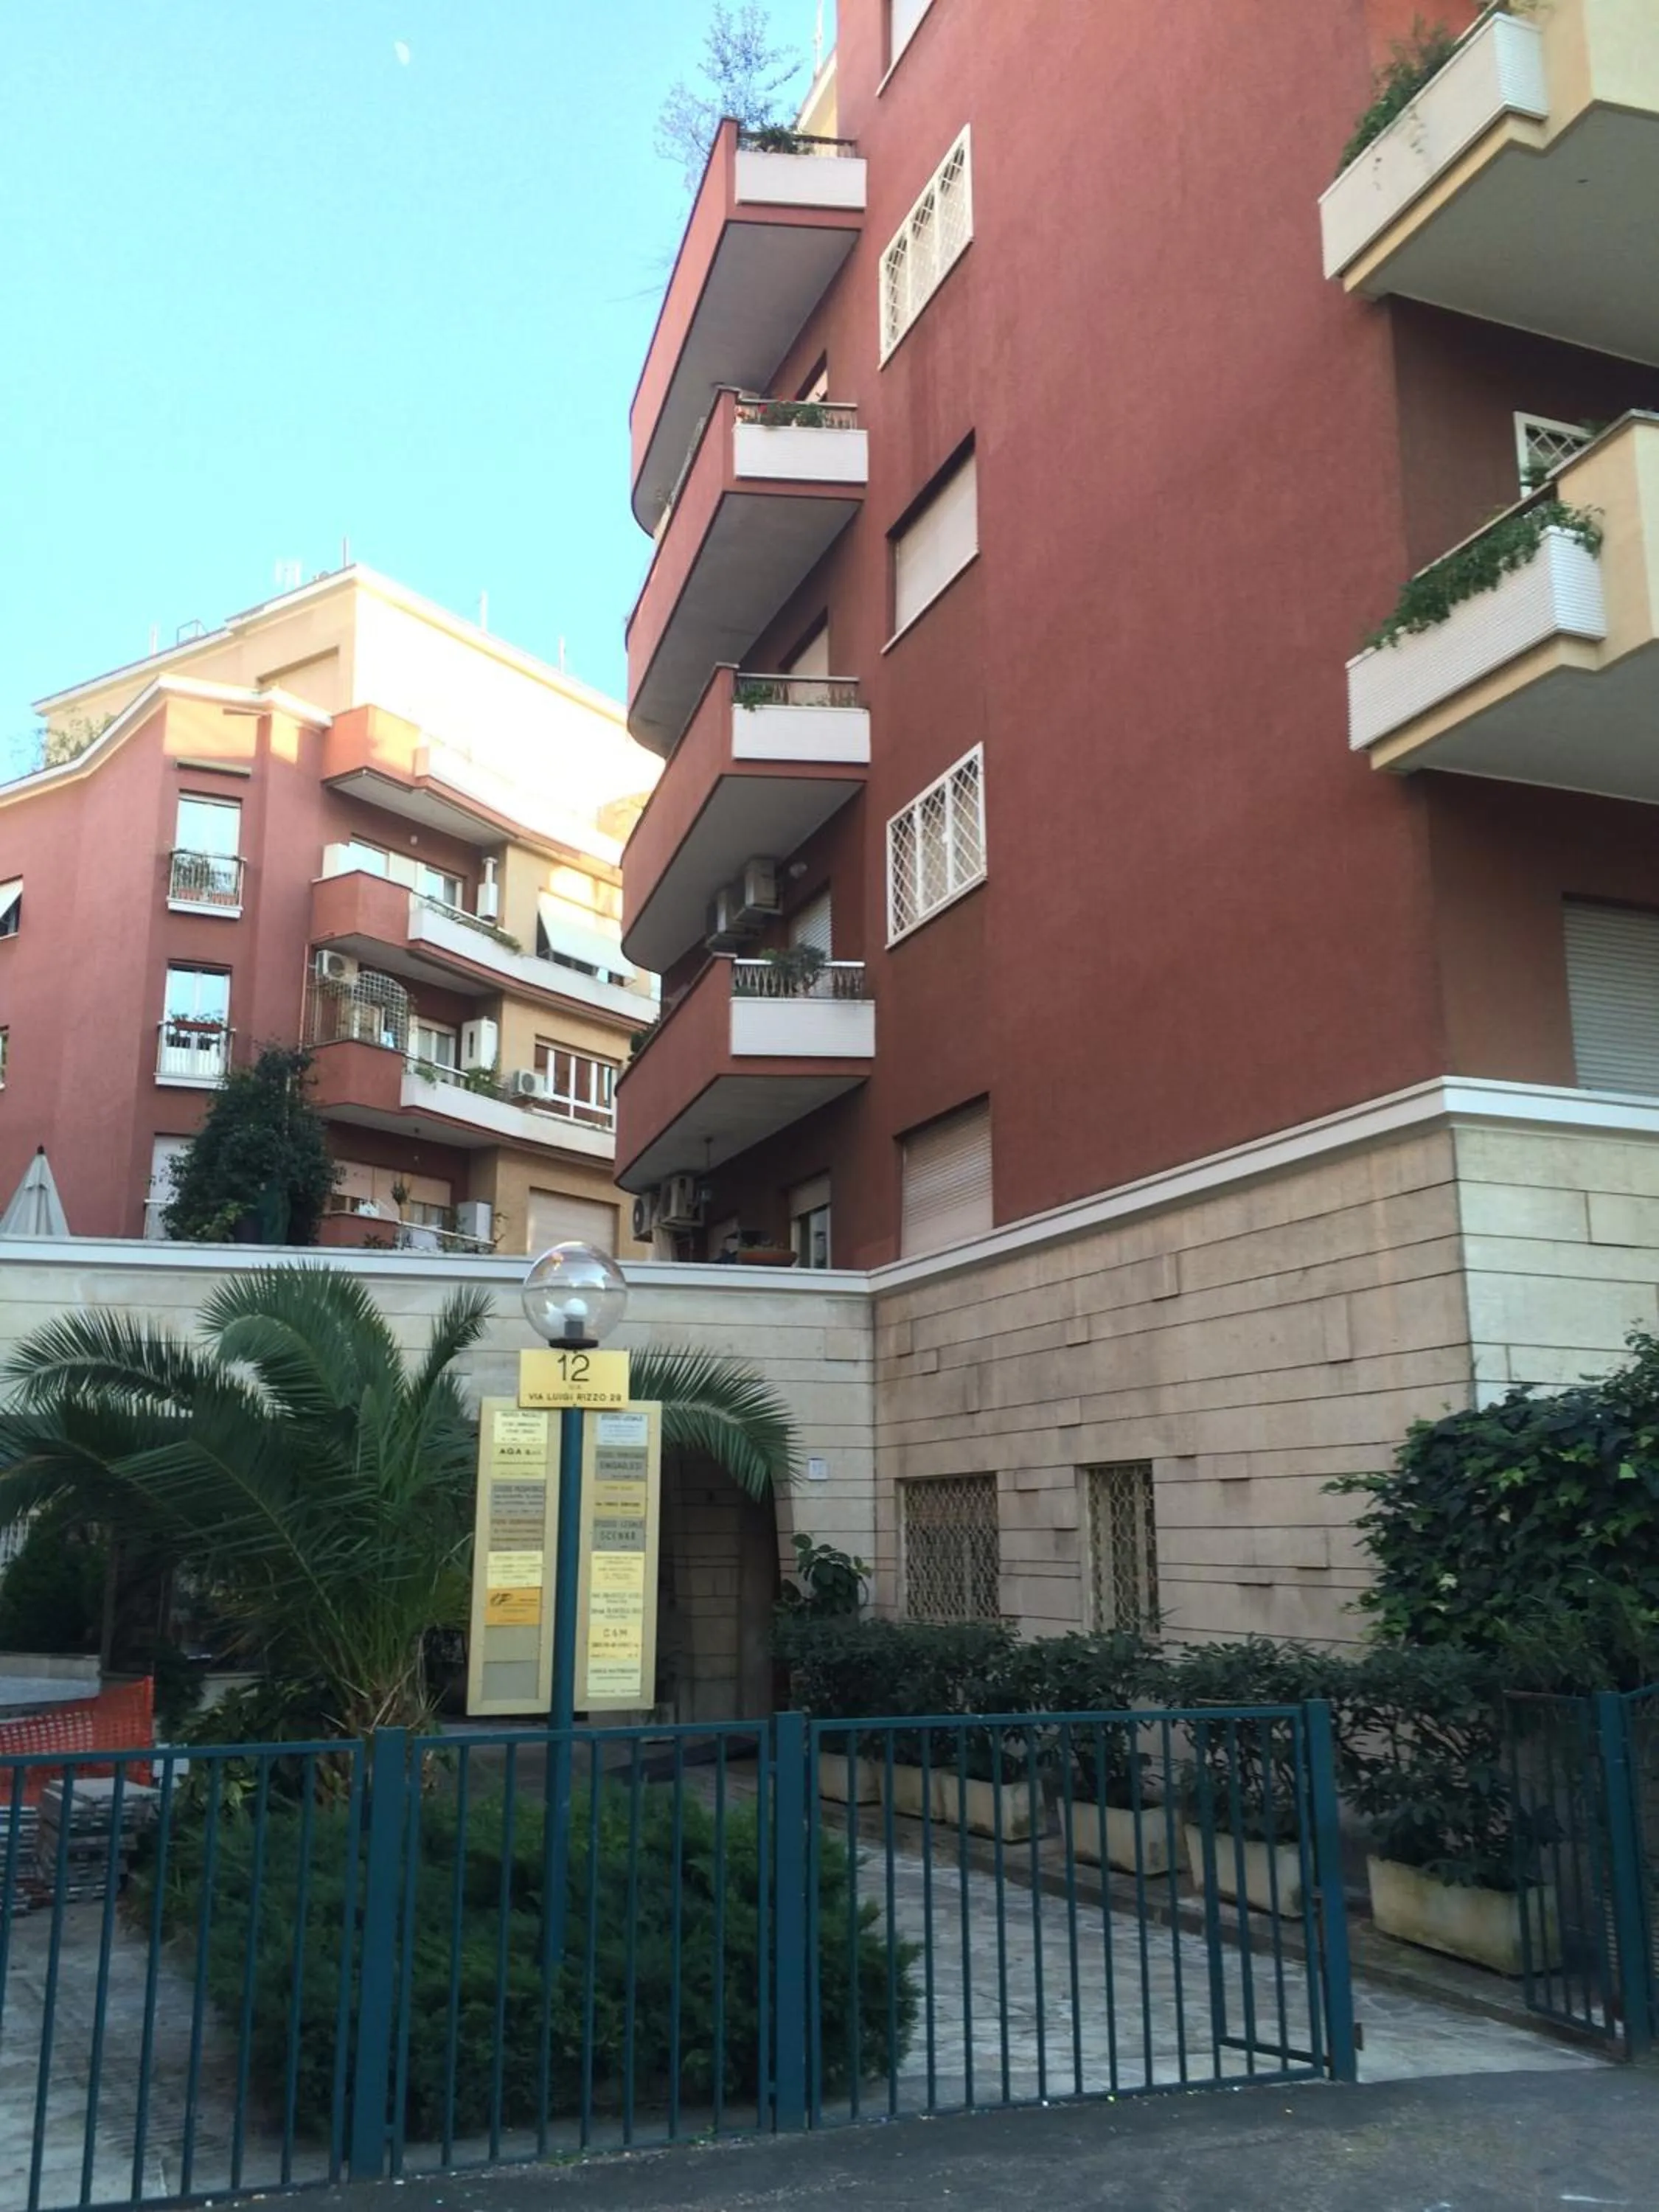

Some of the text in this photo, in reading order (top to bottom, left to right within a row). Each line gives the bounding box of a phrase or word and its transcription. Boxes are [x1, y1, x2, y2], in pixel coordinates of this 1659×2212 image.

[557, 1354, 590, 1382] 12
[529, 1393, 543, 1401] VIA
[546, 1393, 574, 1402] LUIGI
[577, 1393, 606, 1402] RIZZO
